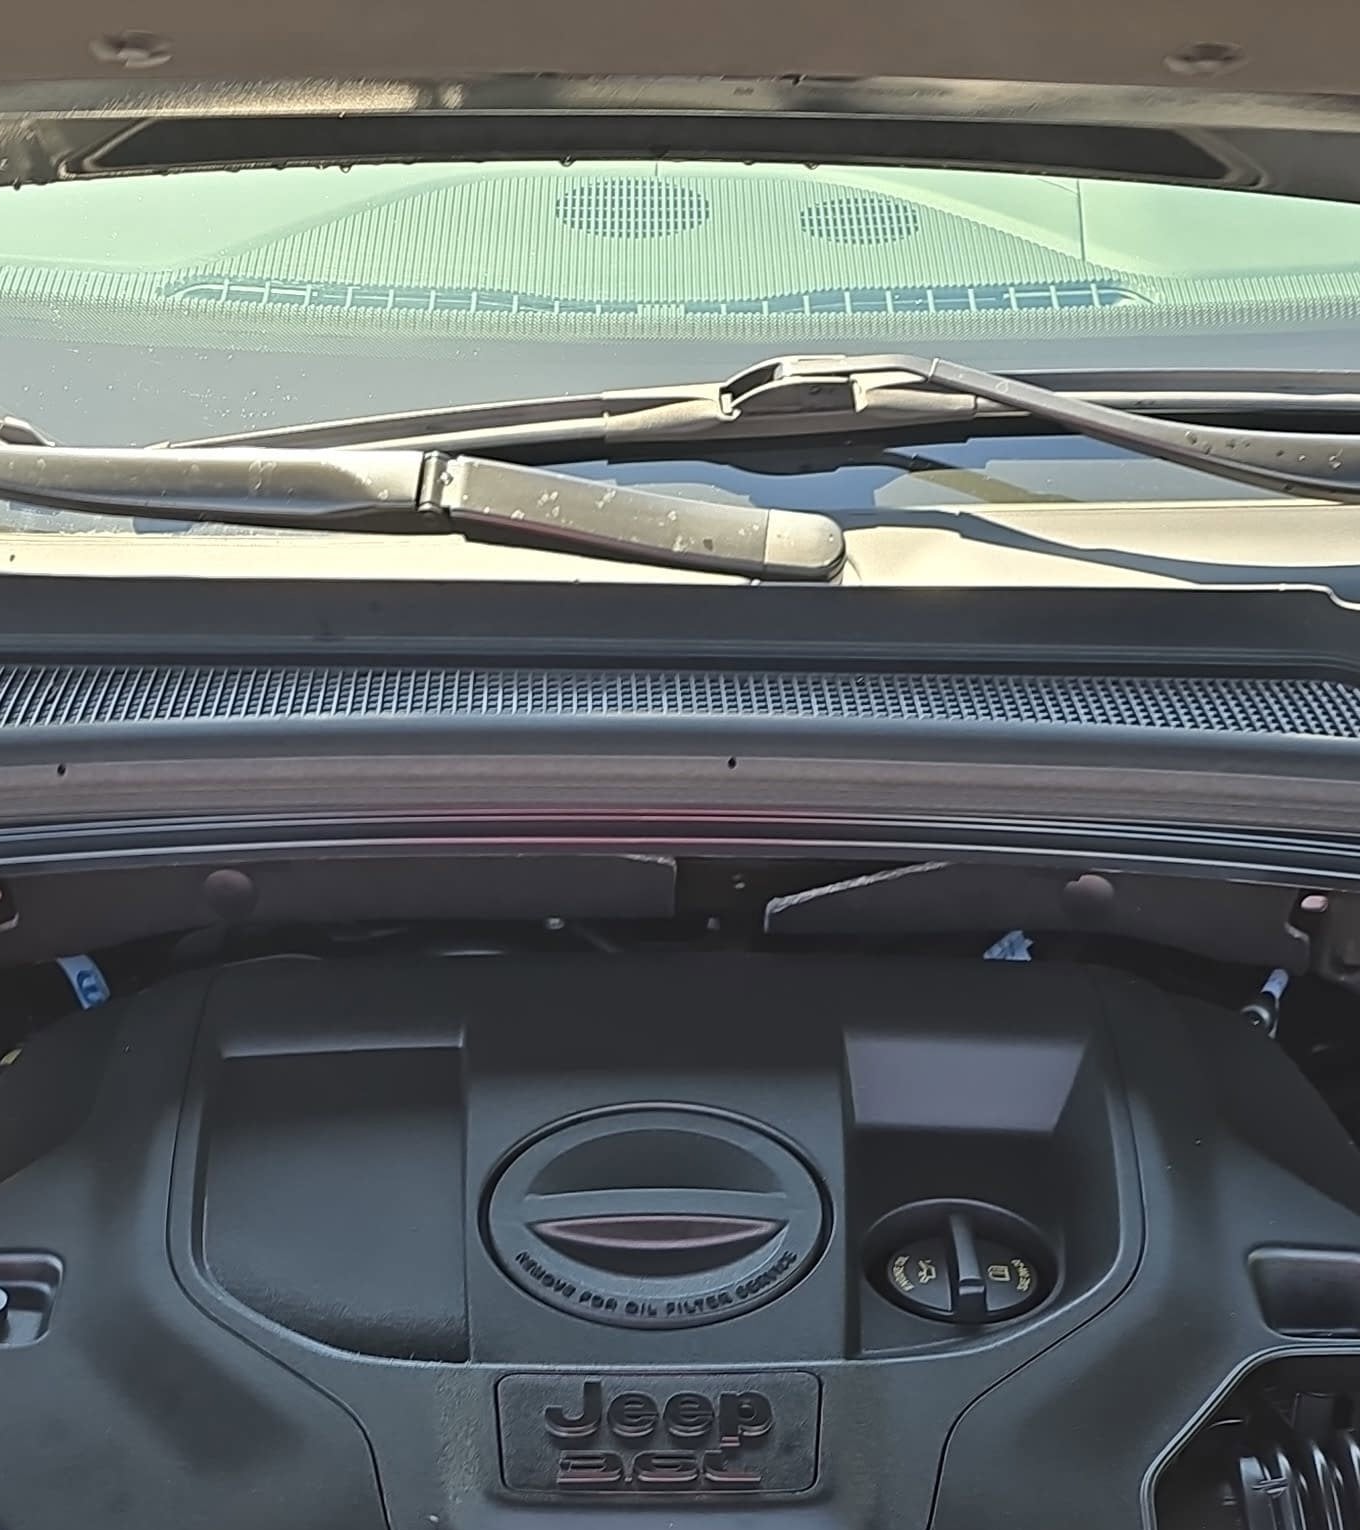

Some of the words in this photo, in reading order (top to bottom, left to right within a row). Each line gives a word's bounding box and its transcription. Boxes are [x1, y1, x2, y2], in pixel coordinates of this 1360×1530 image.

[579, 1290, 618, 1313] FOR
[625, 1300, 658, 1316] OIL
[665, 1290, 733, 1316] FILTER
[544, 1378, 774, 1446] Jeep
